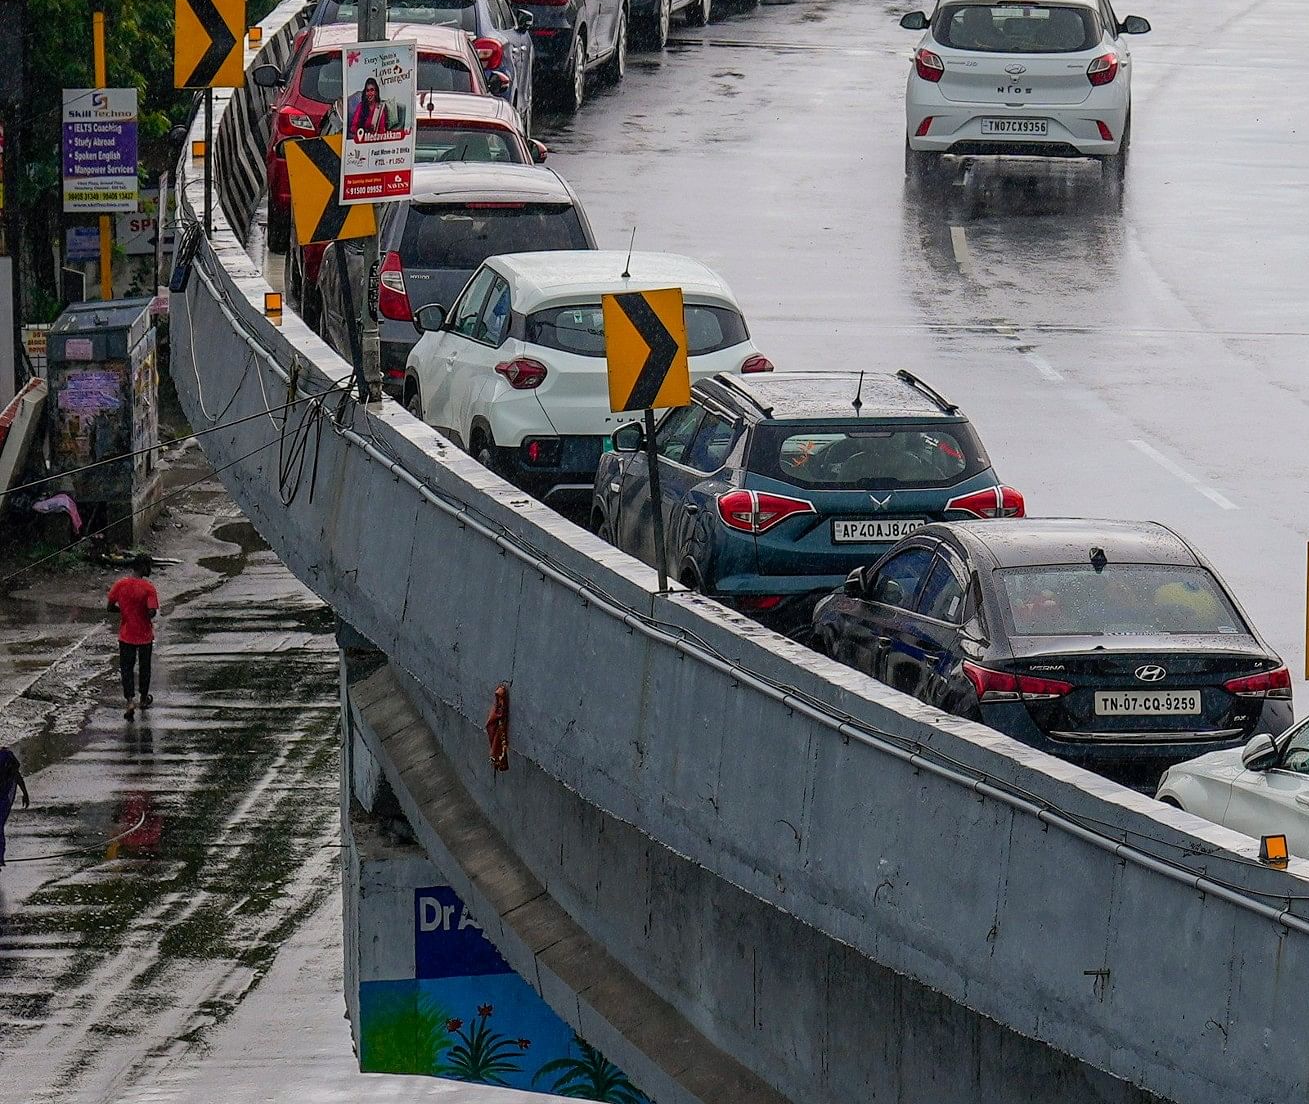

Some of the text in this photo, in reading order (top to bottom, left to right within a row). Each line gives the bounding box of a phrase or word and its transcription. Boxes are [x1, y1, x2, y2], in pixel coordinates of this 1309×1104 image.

[74, 124, 122, 134] IELTS Coaching
[988, 120, 1046, 132] TN07CX9356
[74, 137, 115, 148] Study Abroad
[74, 151, 120, 162] Spoken English
[74, 166, 134, 176] Manpower Services
[1029, 664, 1066, 672] VERNA
[1101, 696, 1197, 713] TN-07-CQ-9259
